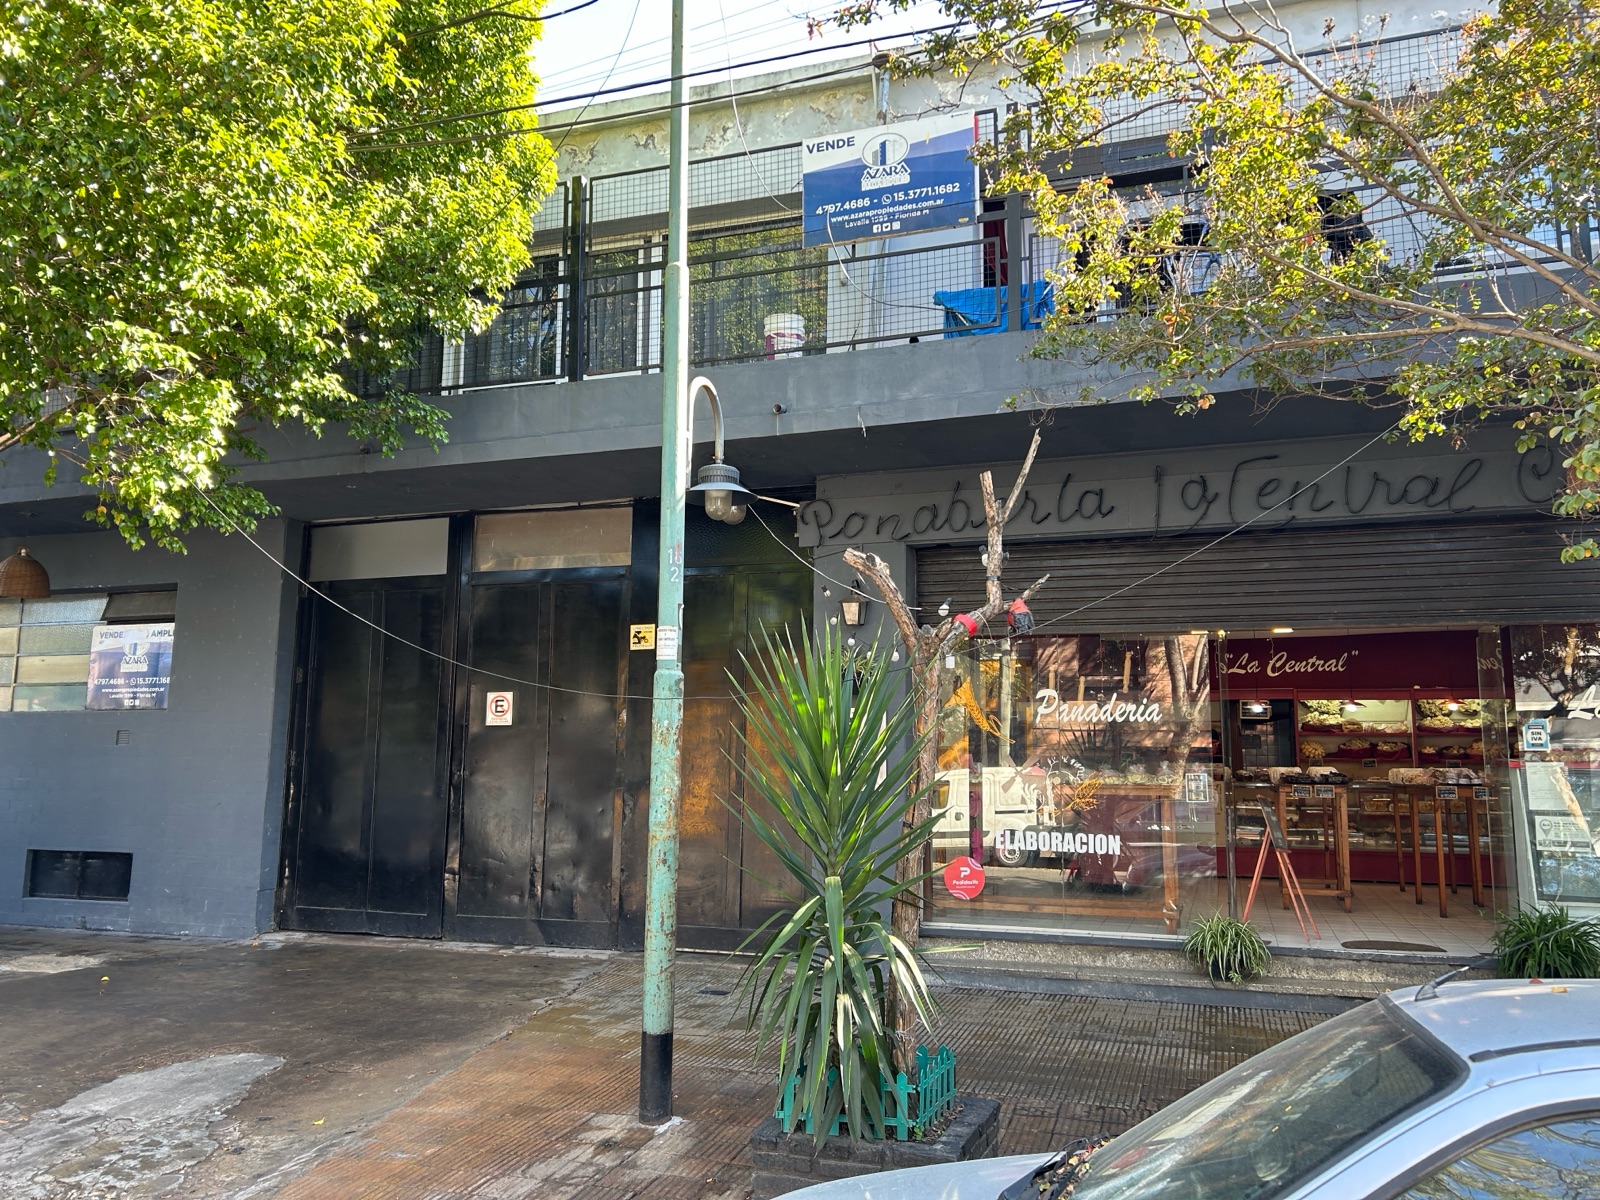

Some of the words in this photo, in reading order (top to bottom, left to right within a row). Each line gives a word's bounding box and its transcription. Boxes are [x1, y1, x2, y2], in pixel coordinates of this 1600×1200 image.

[806, 136, 856, 154] VENDE
[863, 163, 909, 181] AZARA
[816, 197, 871, 215] 4797.4686
[893, 182, 960, 202] 15.3771.1682
[831, 198, 944, 223] www.azarapropiedades.com.ar
[845, 218, 870, 228] Lavalle
[670, 566, 680, 582] 2
[99, 631, 124, 640] VENDE
[121, 656, 148, 664] AZARA
[94, 677, 125, 686] 4797.4686
[495, 699, 505, 713] E
[1035, 688, 1163, 724] Panaderia
[995, 829, 1121, 856] ELABORACION
